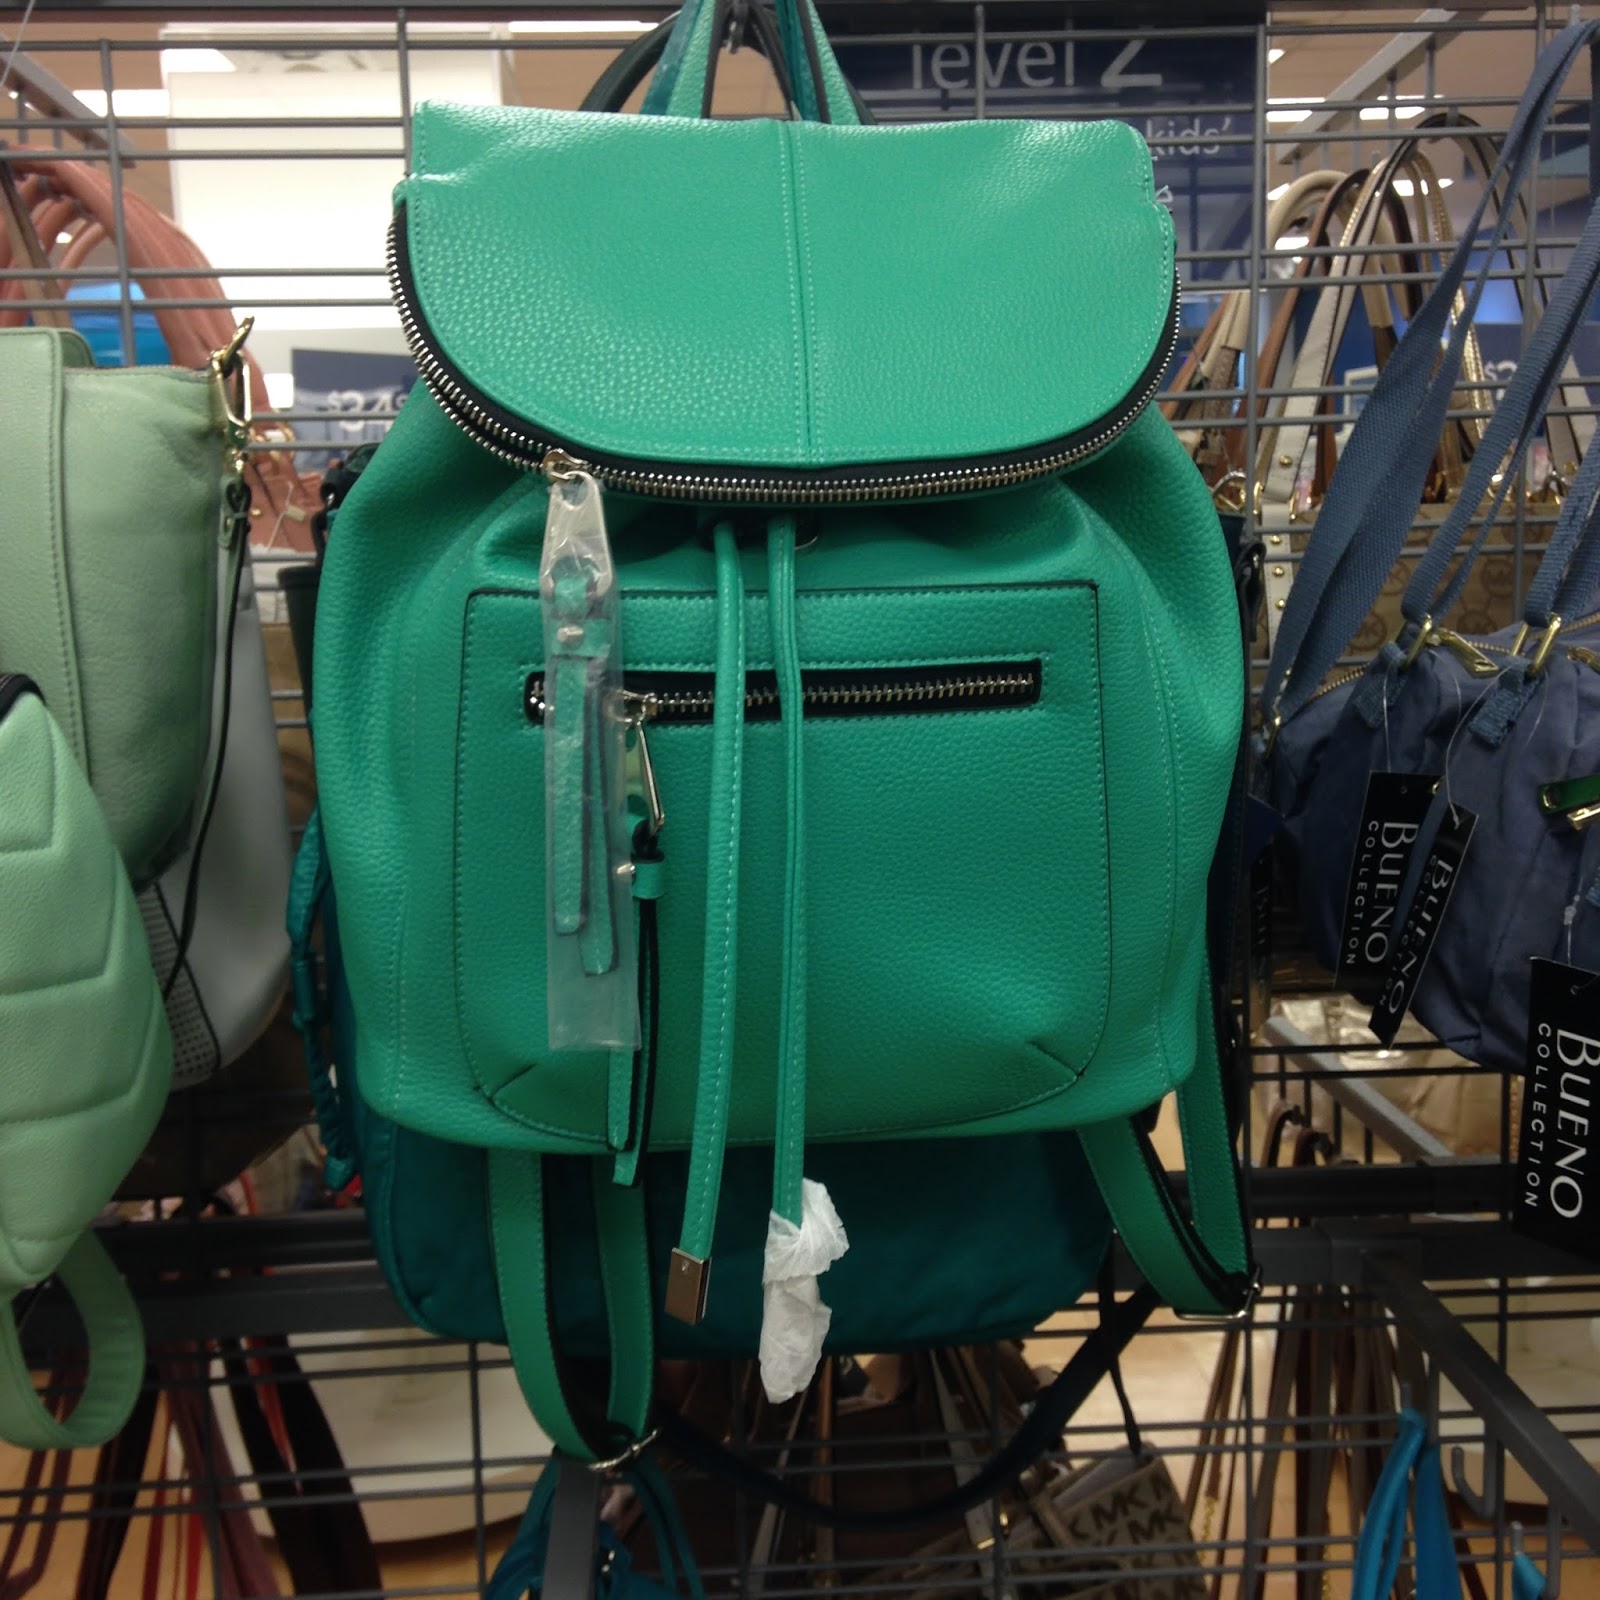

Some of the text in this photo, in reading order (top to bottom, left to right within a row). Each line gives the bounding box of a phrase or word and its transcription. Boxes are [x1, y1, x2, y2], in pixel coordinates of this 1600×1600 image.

[912, 28, 1075, 90] level
[1146, 117, 1231, 155] kids'
[1346, 820, 1379, 964] COLLECTION
[1524, 1022, 1552, 1207] COLLECTION
